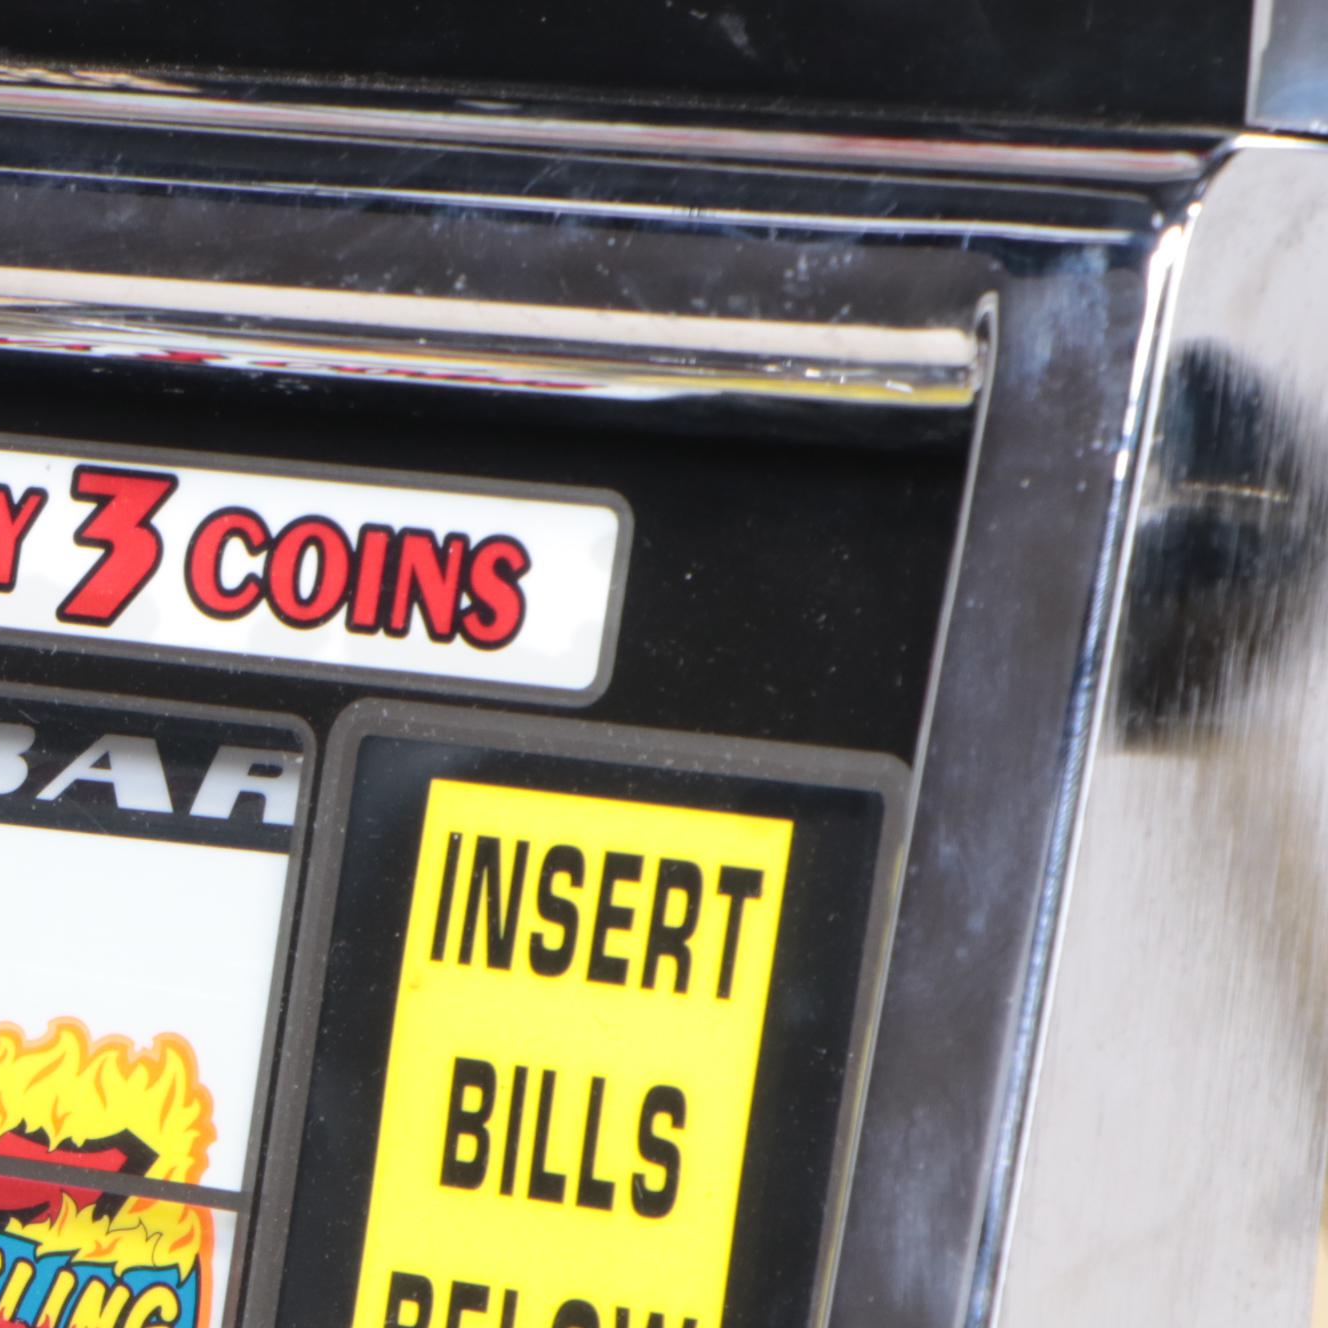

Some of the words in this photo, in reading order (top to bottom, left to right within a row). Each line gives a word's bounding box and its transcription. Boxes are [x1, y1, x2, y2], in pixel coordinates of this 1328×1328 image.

[55, 464, 180, 627] 3
[185, 507, 533, 652] COINS
[429, 831, 765, 1001] INSERT
[439, 1056, 688, 1220] BILLS
